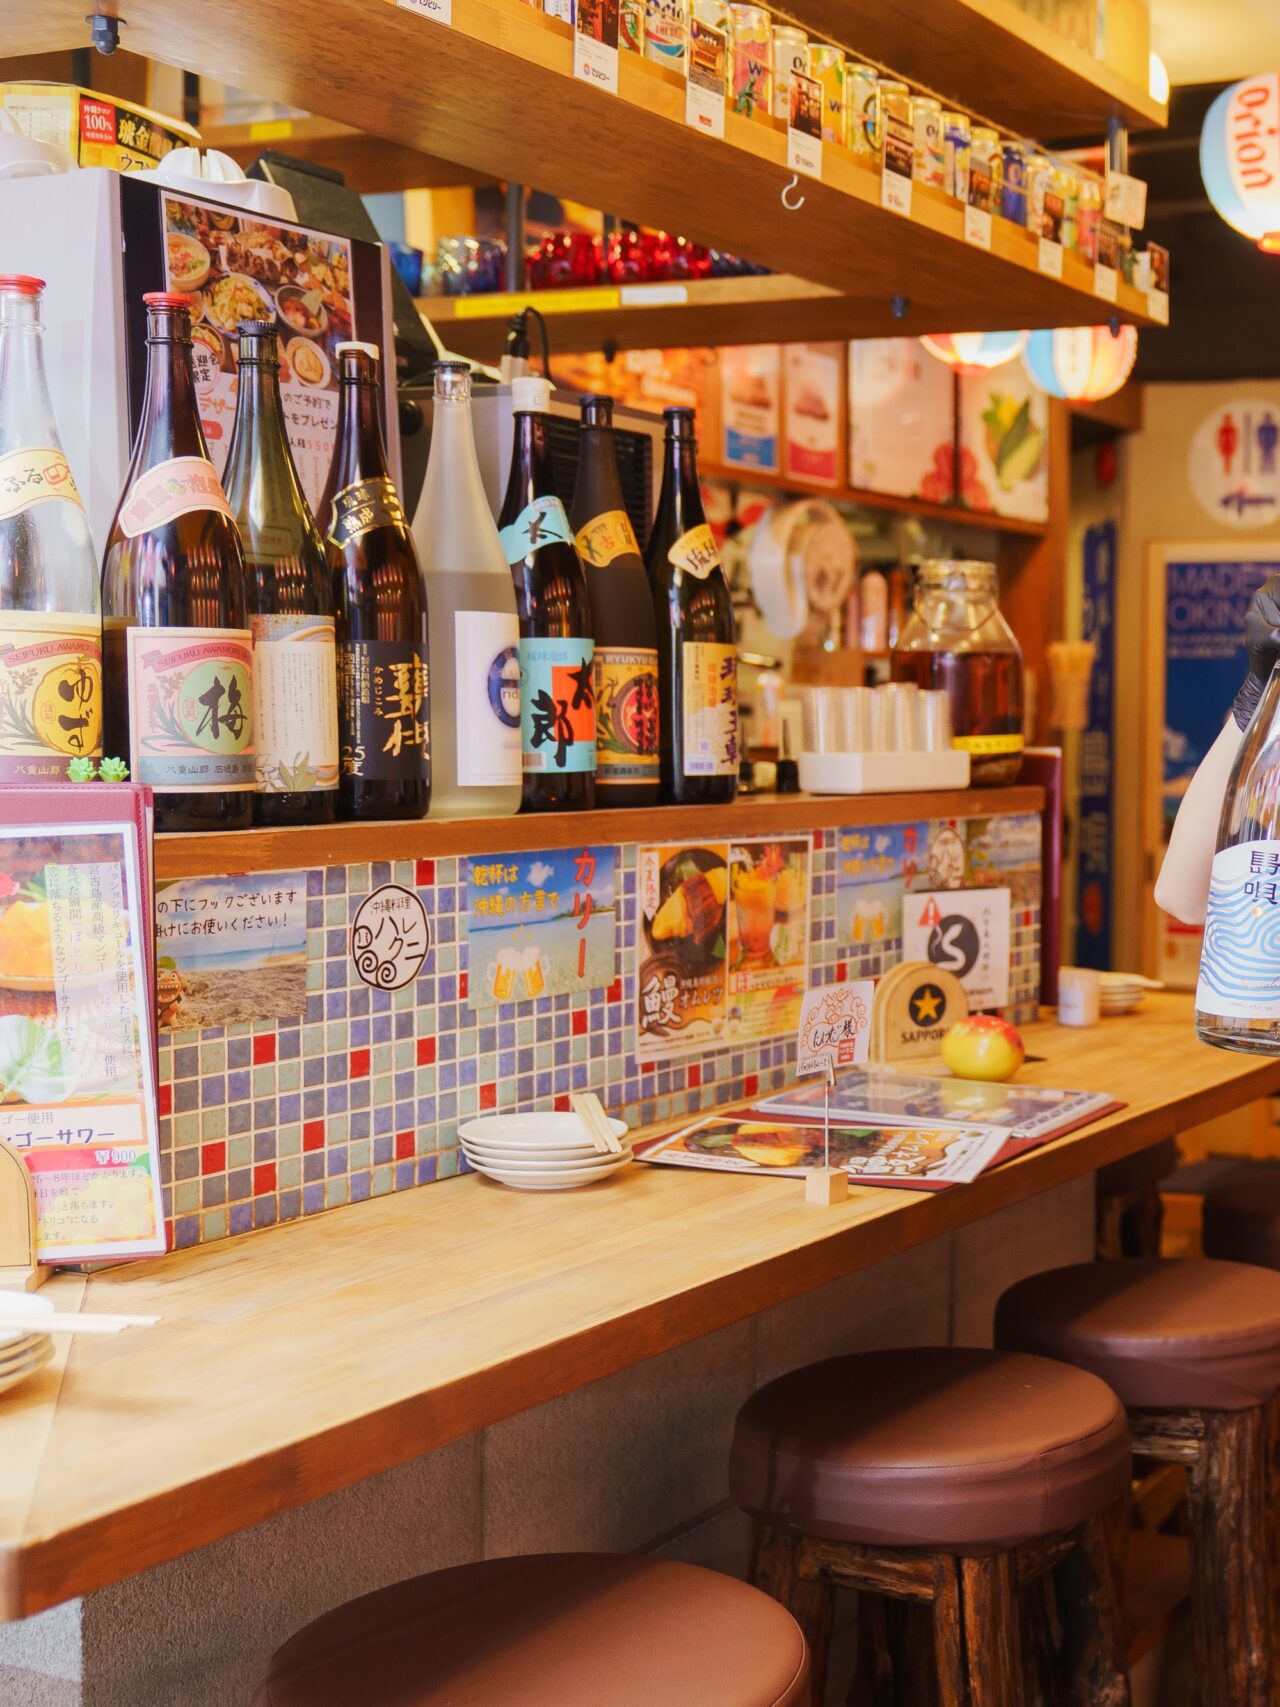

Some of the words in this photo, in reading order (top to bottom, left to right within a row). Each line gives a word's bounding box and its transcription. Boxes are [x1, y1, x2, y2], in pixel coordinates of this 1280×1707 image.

[85, 114, 113, 132] 100%
[1234, 86, 1279, 189] Orion
[8, 643, 55, 663] SEIFUKU
[58, 669, 94, 753] ゆず
[196, 675, 248, 741] 梅
[472, 863, 519, 887] 乾杯は
[157, 889, 298, 914] の下にフックございます
[472, 888, 560, 918] 沖縄の方言で
[573, 849, 597, 979] カリー
[375, 915, 418, 940] ハレ
[642, 974, 682, 1029] 鰻
[679, 986, 723, 1009] オムレツ
[901, 1028, 949, 1044] SAPPOR
[7, 1128, 115, 1148] ゴーサワー
[95, 1150, 136, 1165] ¥900
